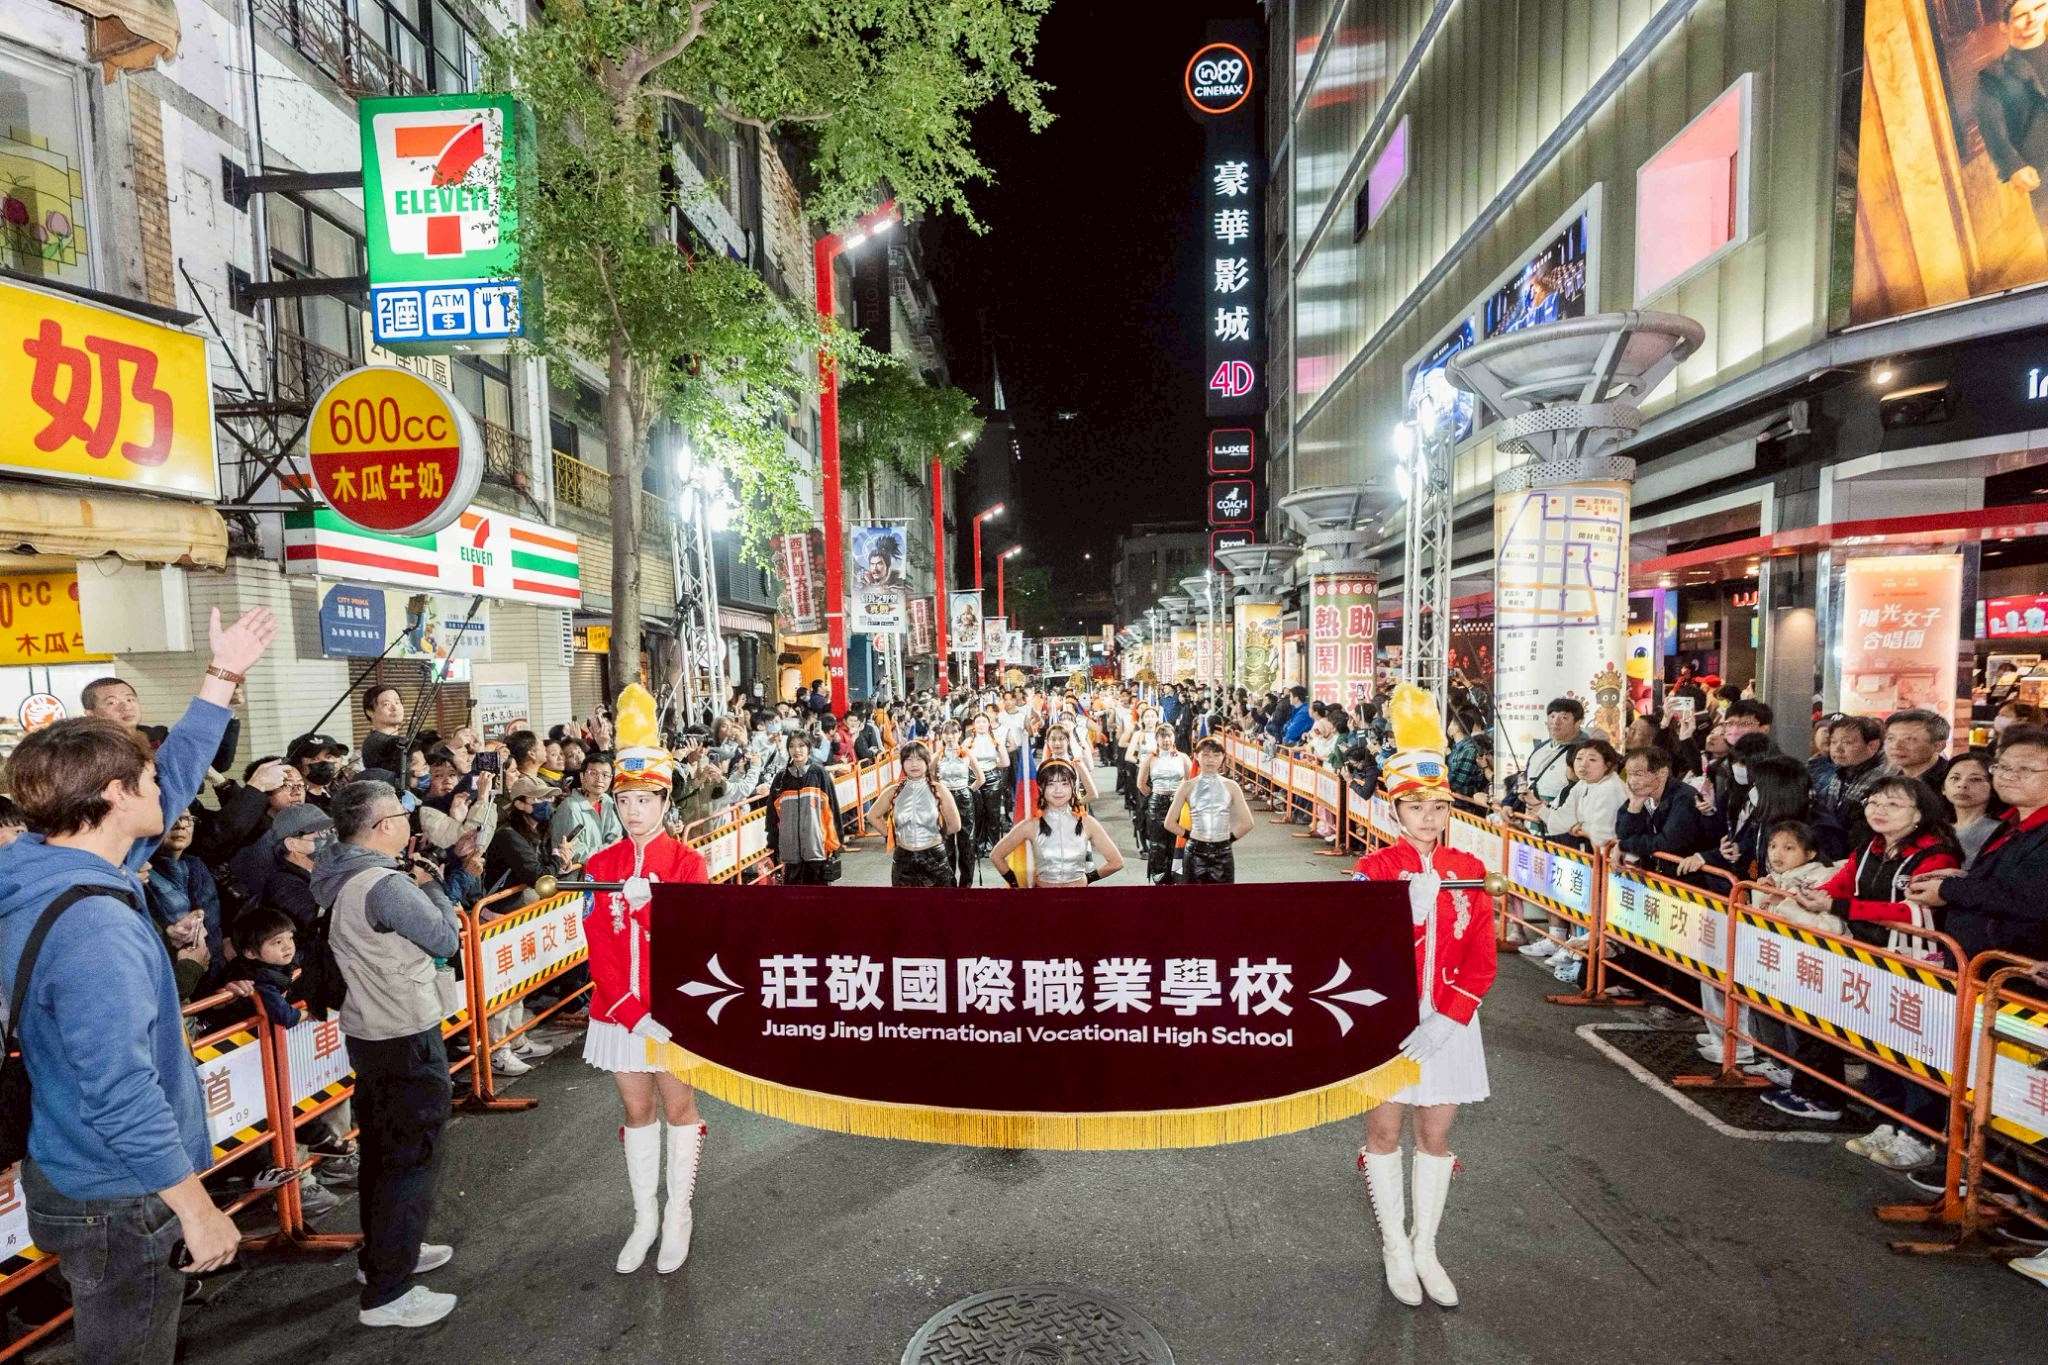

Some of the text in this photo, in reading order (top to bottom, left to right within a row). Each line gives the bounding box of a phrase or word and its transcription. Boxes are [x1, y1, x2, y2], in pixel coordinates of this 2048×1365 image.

[1194, 84, 1244, 97] CINEMAX
[1213, 161, 1250, 342] 豪華影城
[432, 294, 464, 308] ATM
[22, 318, 174, 467] 奶
[1209, 360, 1255, 397] 4D
[329, 396, 448, 446] 600cc
[332, 462, 444, 502] 木瓜牛奶
[1216, 500, 1248, 509] COACH
[1223, 509, 1240, 517] VIP
[1858, 603, 1941, 628] 陽光女子
[831, 648, 842, 657] W
[1864, 630, 1925, 650] 合唱團
[831, 667, 844, 676] 58
[1620, 885, 1717, 949] 車輛改道
[496, 912, 578, 975] 車輛改道
[759, 953, 1294, 1017] 莊敬國際職業學校
[1756, 936, 1924, 1036] 車輛改道
[313, 1017, 341, 1060] 車
[762, 1019, 1293, 1047] Juang Jing International Vocational High School
[228, 1107, 249, 1126] 109
